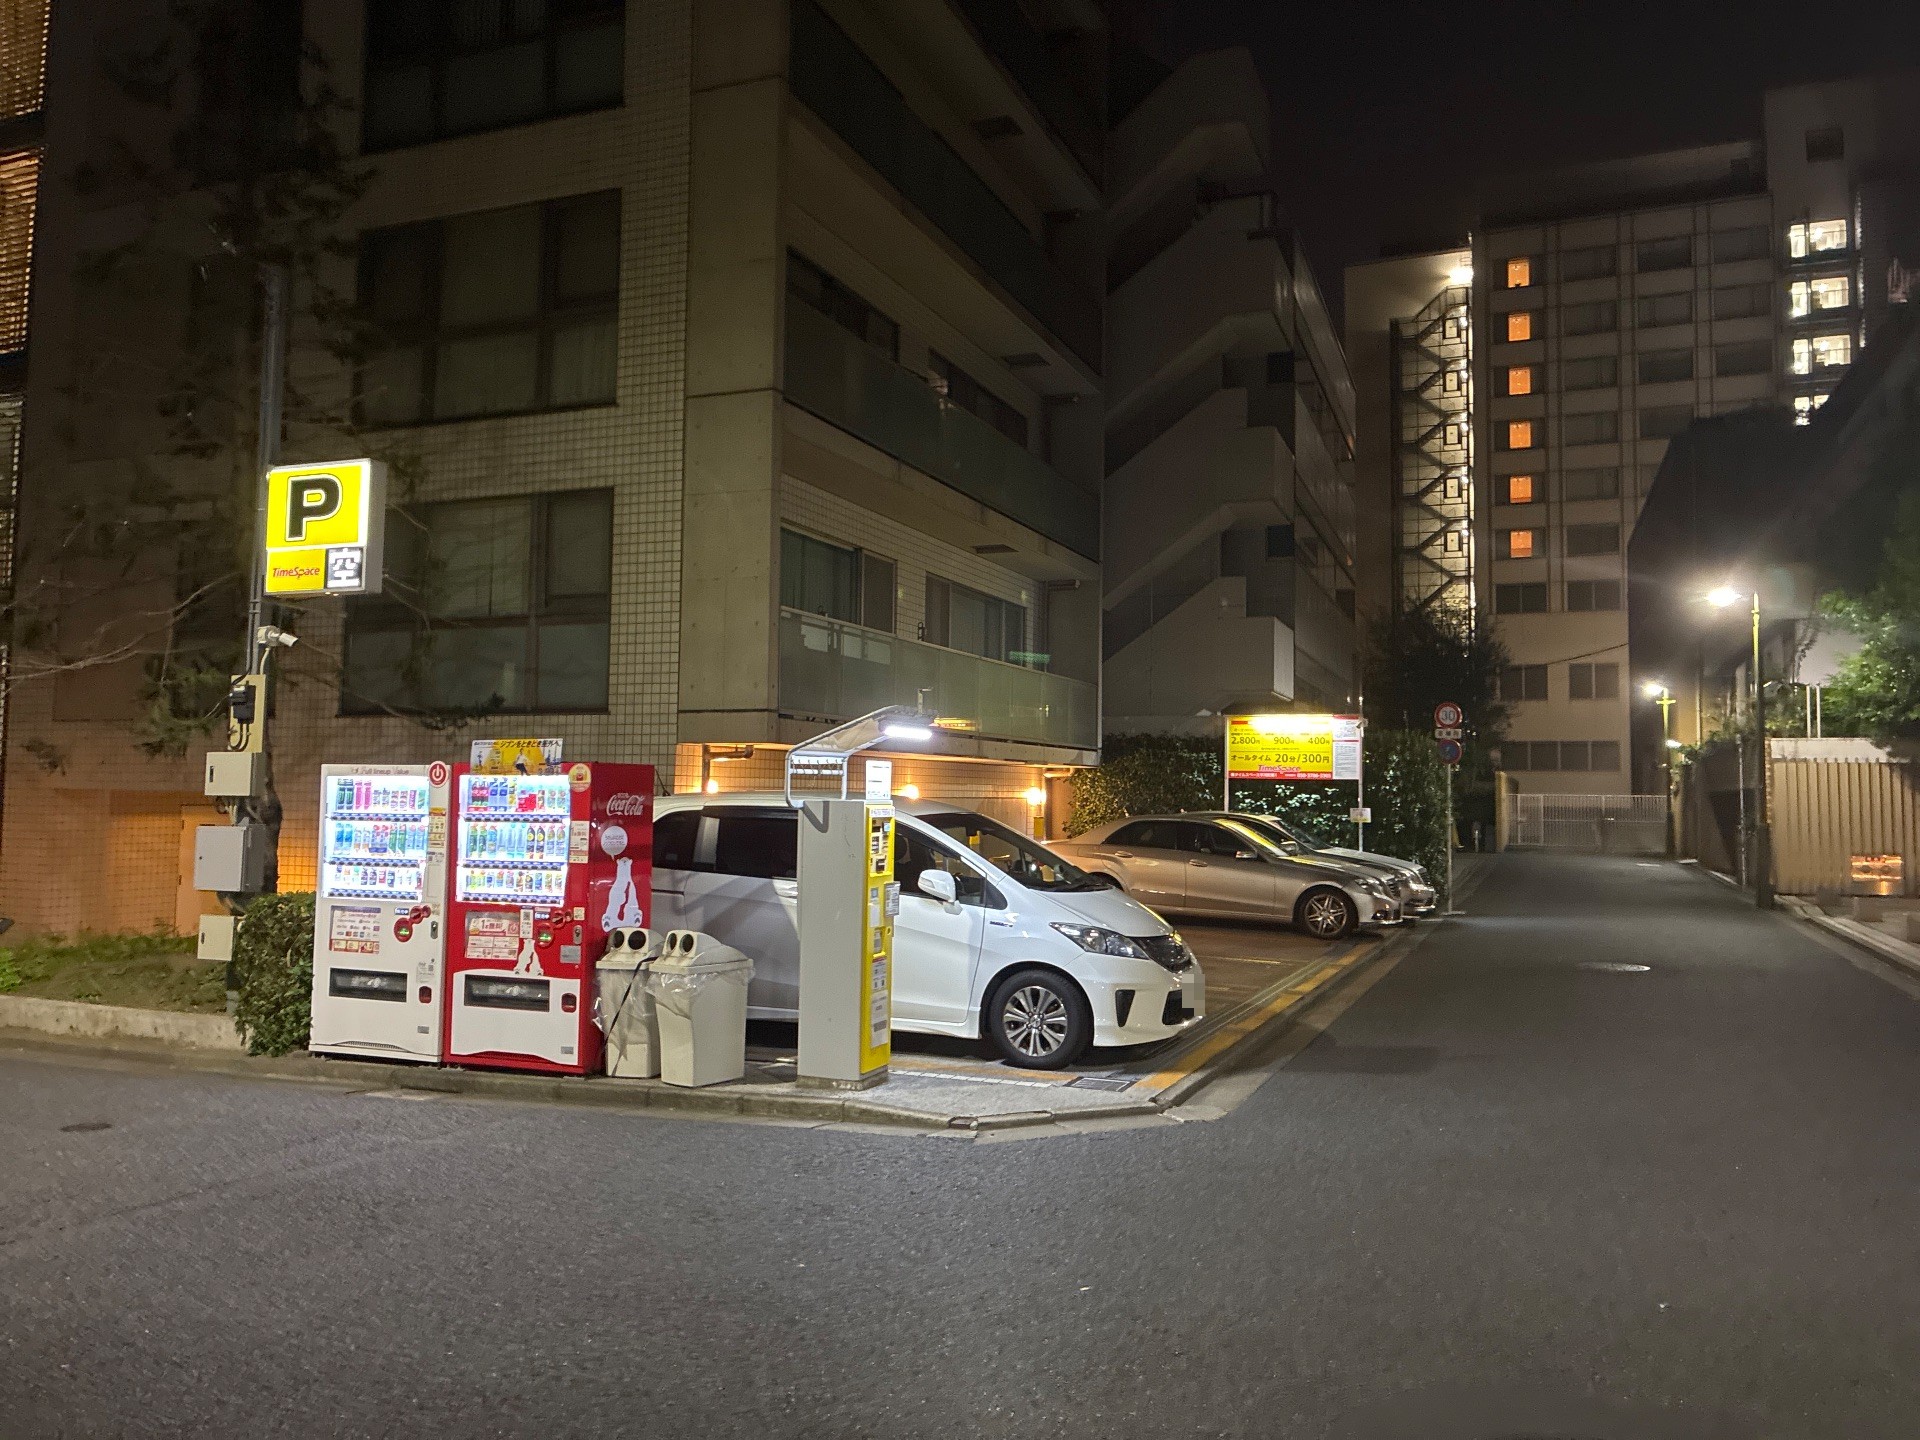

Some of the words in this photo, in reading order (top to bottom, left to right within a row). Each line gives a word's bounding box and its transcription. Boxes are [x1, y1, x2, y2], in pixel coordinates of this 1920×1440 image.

[286, 474, 343, 541] P
[272, 567, 320, 579] TimeSpace
[328, 548, 361, 588] 空
[1441, 710, 1456, 721] 30
[1275, 753, 1330, 763] 20分/300円
[1258, 764, 1301, 774] TimeSpace
[606, 795, 645, 816] Coca-Cola
